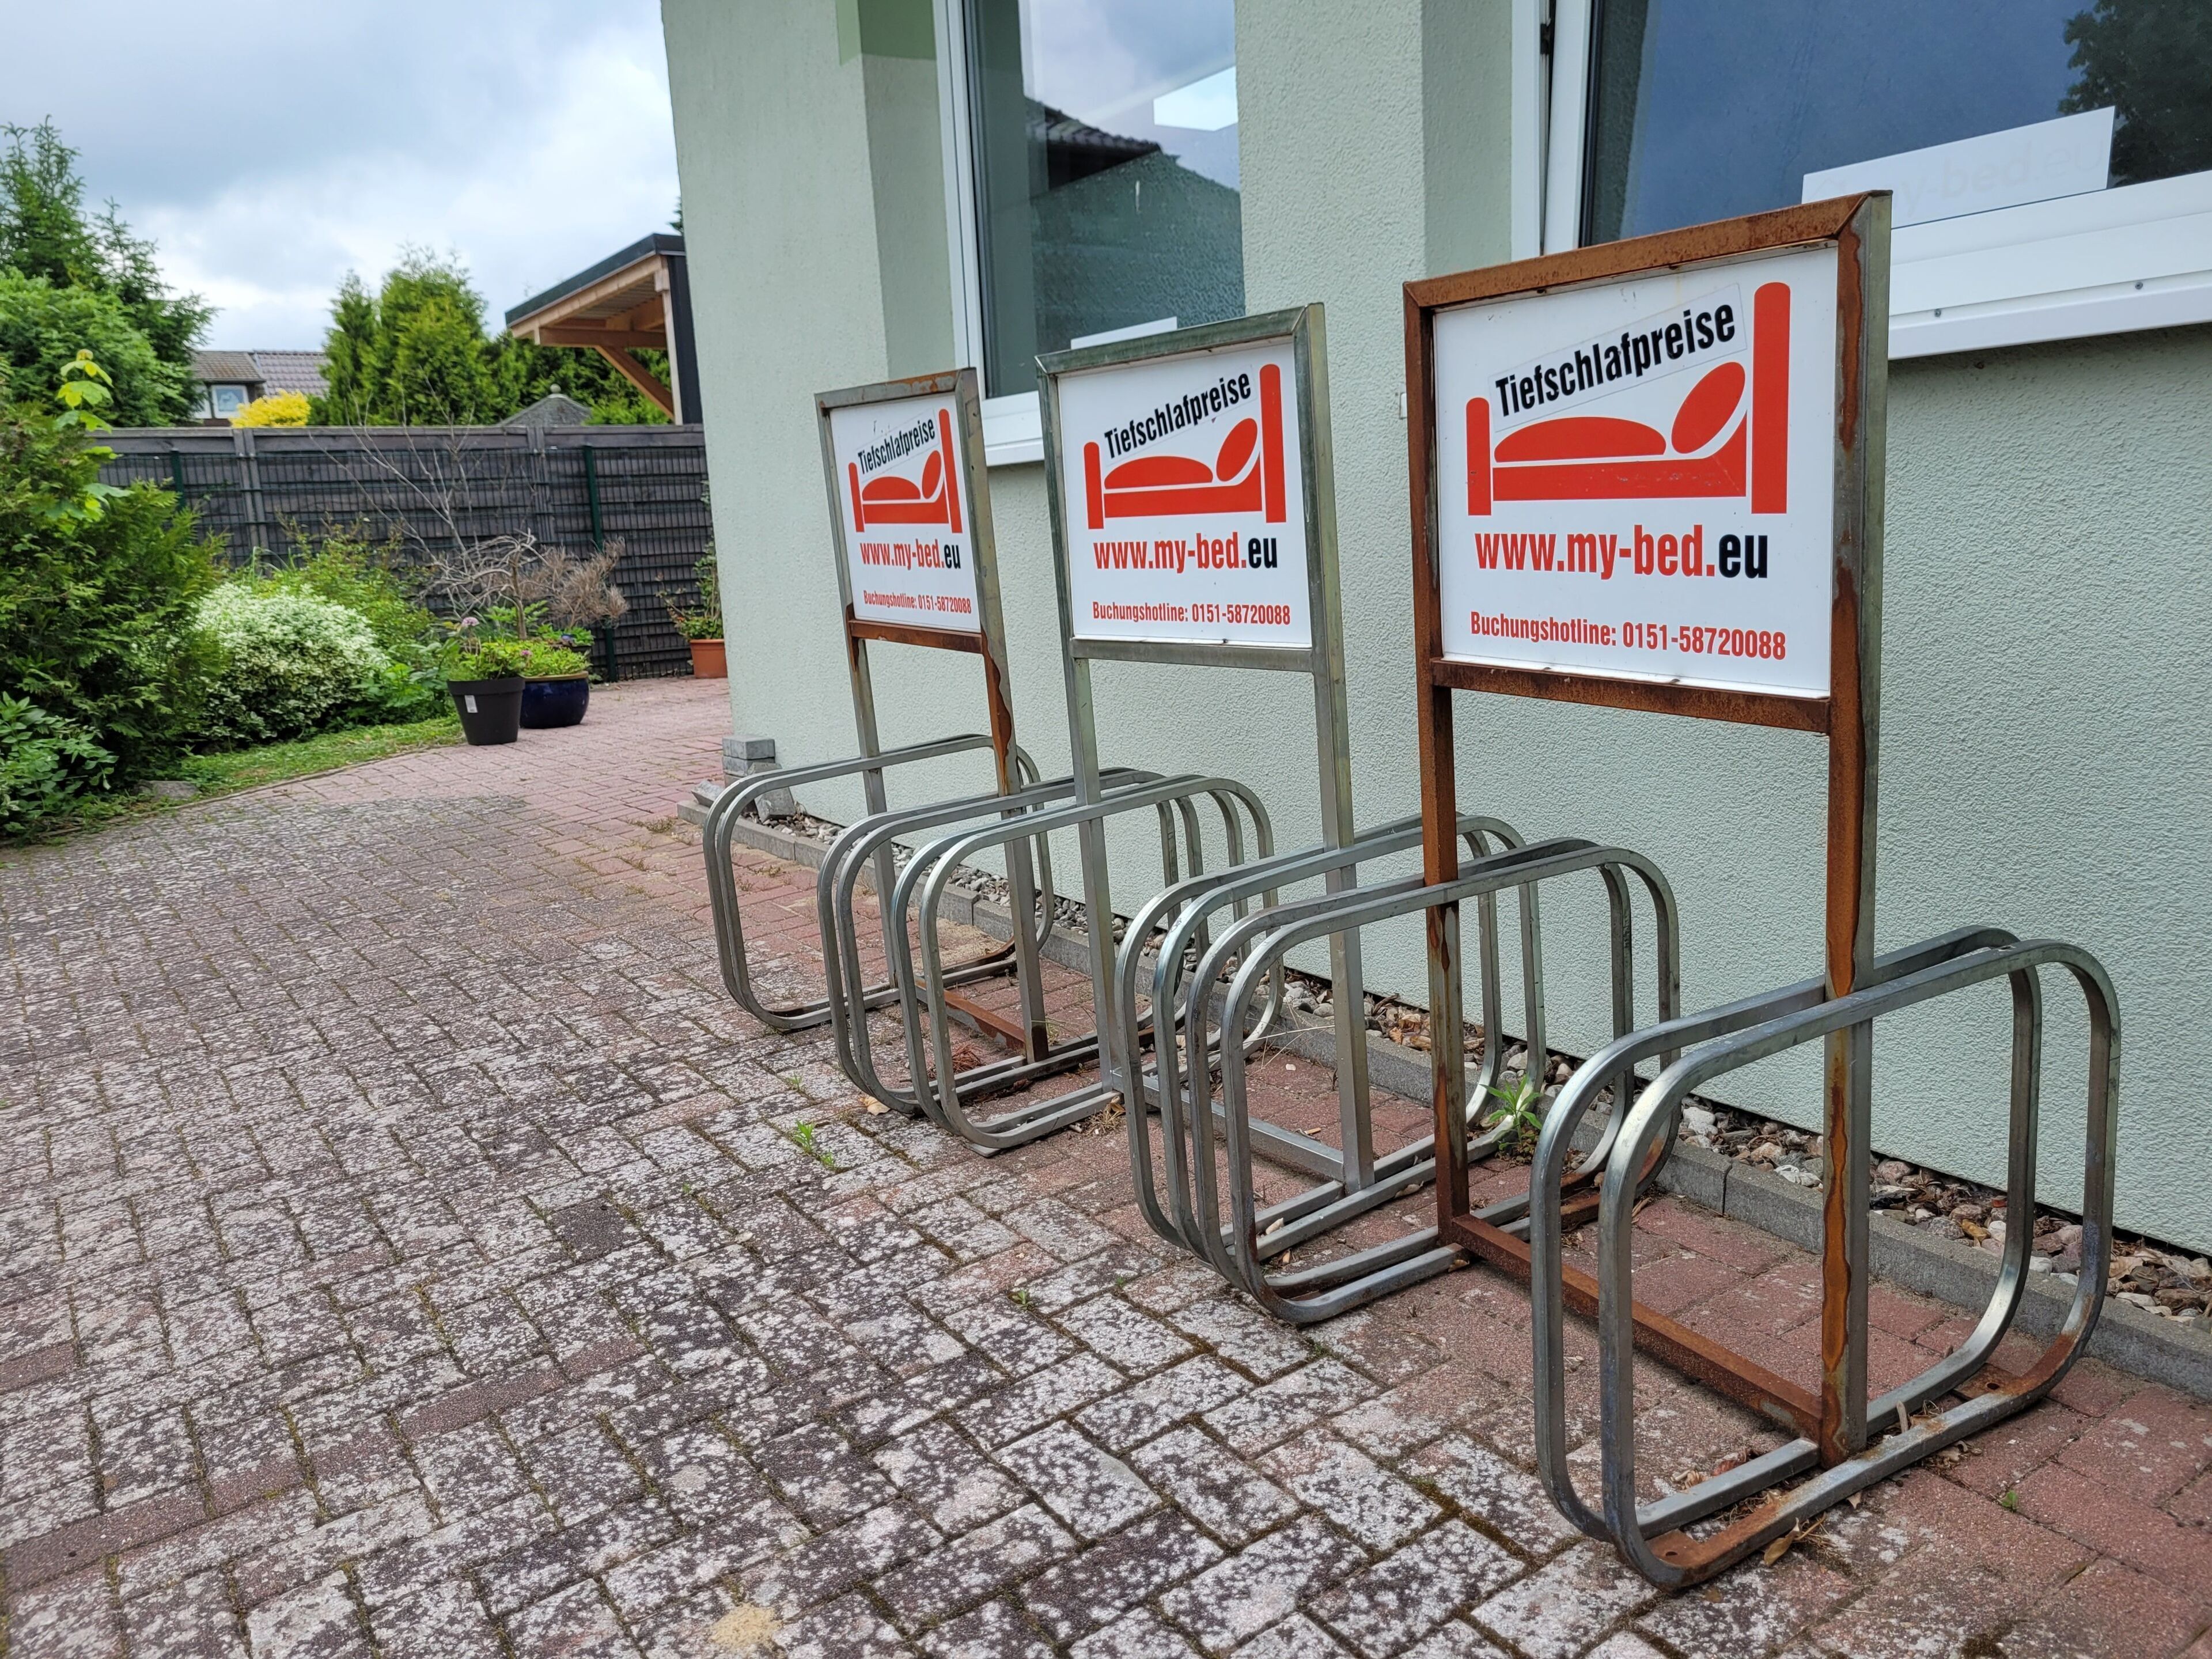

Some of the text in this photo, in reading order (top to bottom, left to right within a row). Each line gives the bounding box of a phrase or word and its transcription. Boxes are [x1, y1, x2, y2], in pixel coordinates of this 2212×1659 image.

[1883, 138, 2104, 218] y-bed.eu
[1494, 304, 1736, 418] Tiefschlafpreise
[1104, 373, 1252, 459] Tiefschlafpreise
[857, 418, 935, 475] Tiefschlafpreise
[859, 538, 961, 571] www.my-bed.eu
[1093, 531, 1278, 574] www.my-bed.eu
[1474, 524, 1768, 580] www.my-bed.eu
[863, 590, 972, 614] Buchungshotline: 0151-58720088
[1092, 601, 1291, 625] Buchungshotline: 0151-58720088
[1470, 611, 1786, 661] Buchungshotline: 0151-58720088
